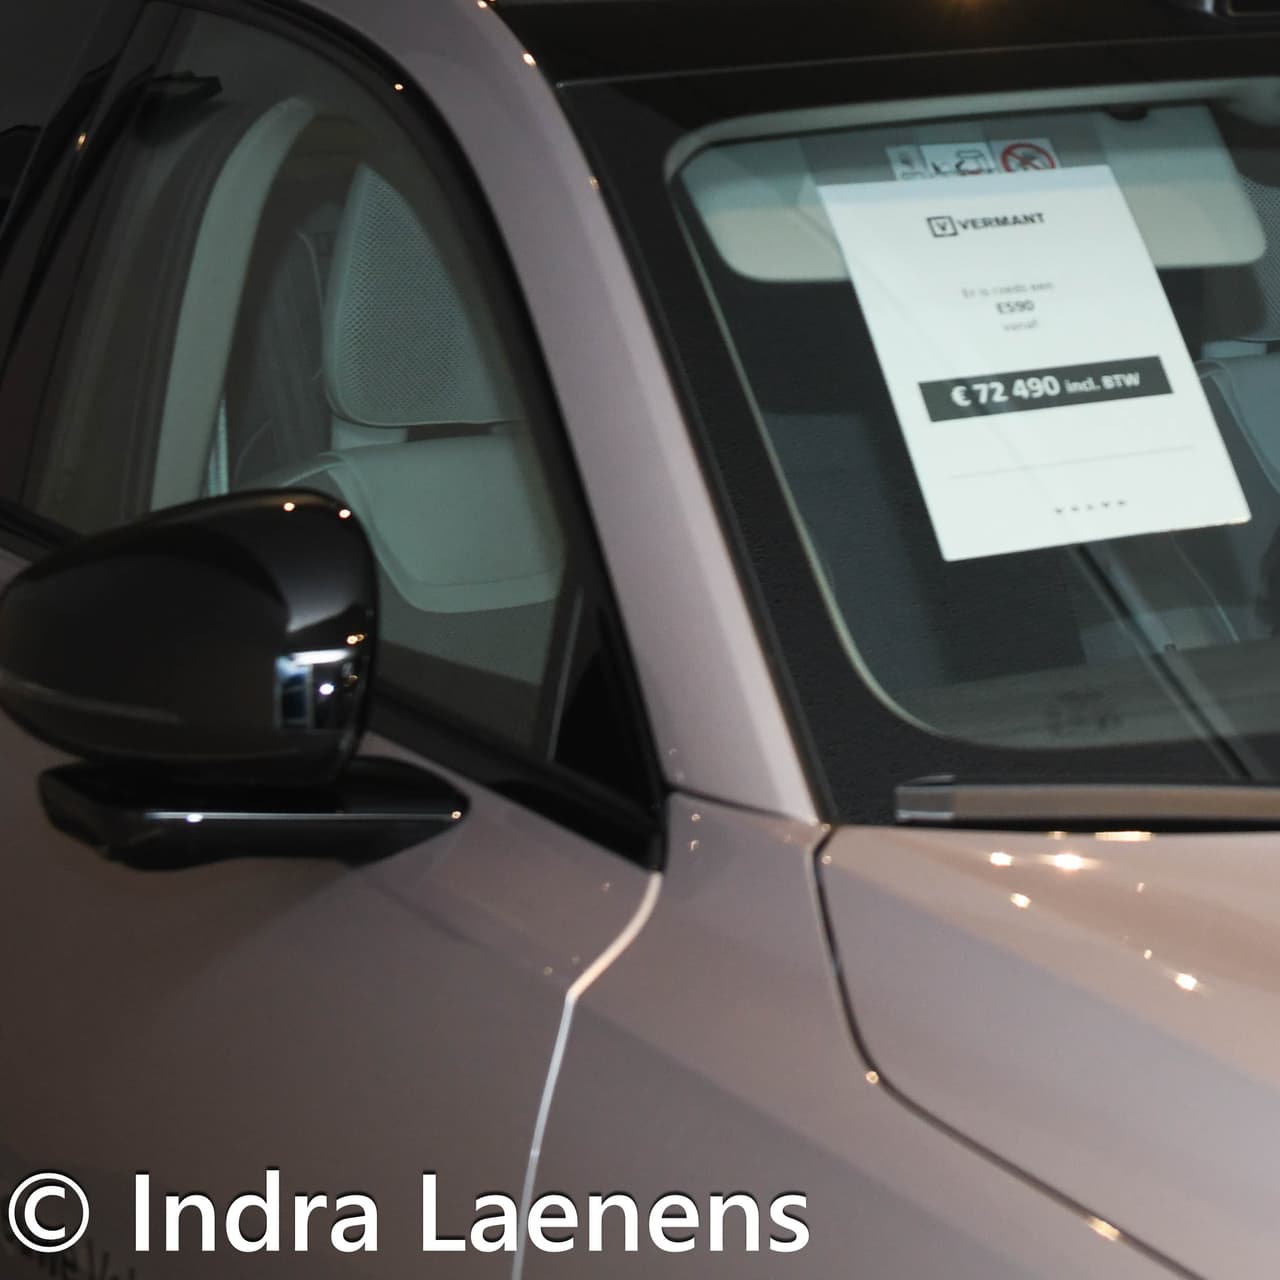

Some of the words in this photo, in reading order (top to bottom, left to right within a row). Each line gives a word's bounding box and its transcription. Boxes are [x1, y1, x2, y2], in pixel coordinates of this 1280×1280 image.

[957, 213, 1045, 230] VERMANT
[951, 386, 972, 407] €
[973, 382, 1009, 404] 72
[1012, 375, 1061, 400] 490
[1065, 377, 1100, 394] incl.
[1101, 372, 1141, 390] BTW
